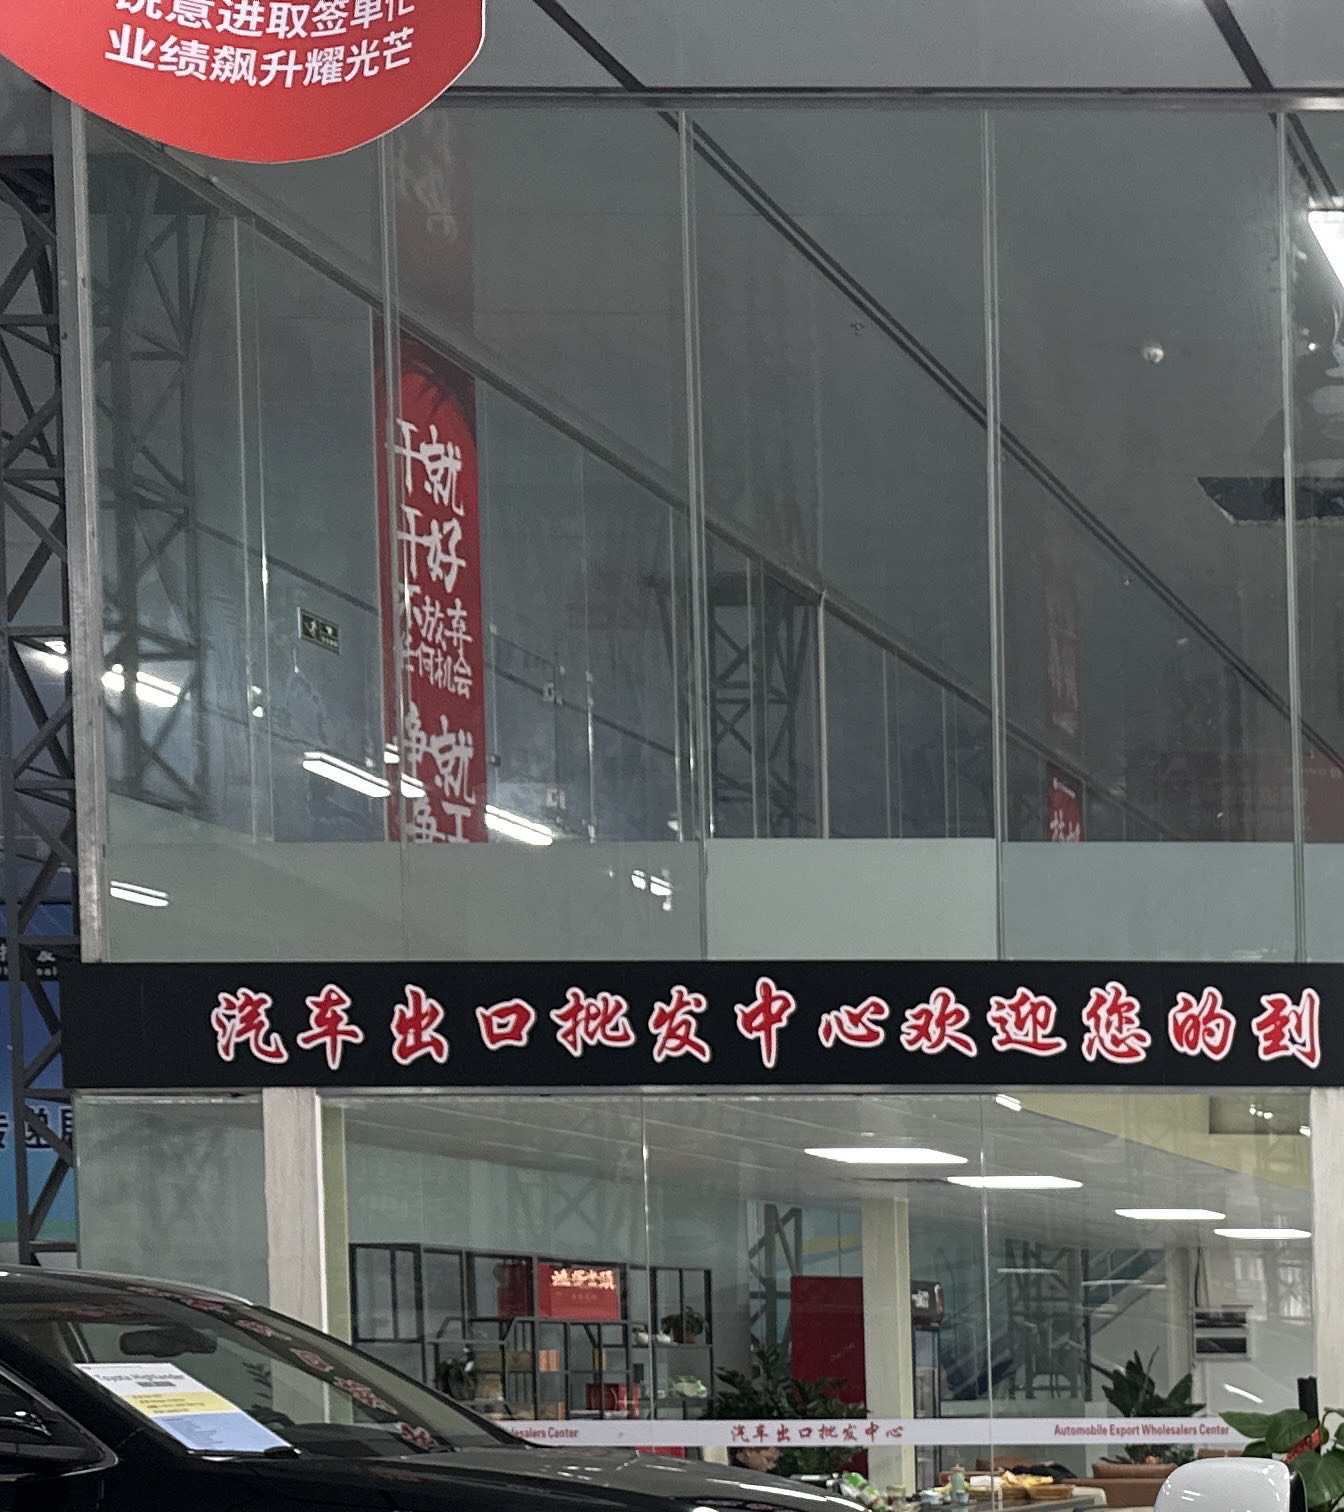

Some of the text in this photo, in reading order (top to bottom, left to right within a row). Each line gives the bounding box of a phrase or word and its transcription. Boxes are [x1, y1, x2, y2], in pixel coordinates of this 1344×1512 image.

[104, 27, 414, 87] 业绩飙升耀光芒
[730, 1423, 903, 1443] 汽车出口批发中心
[1054, 1424, 1107, 1436] Automobile
[1109, 1424, 1140, 1437] Export
[1199, 1424, 1229, 1435] Center
